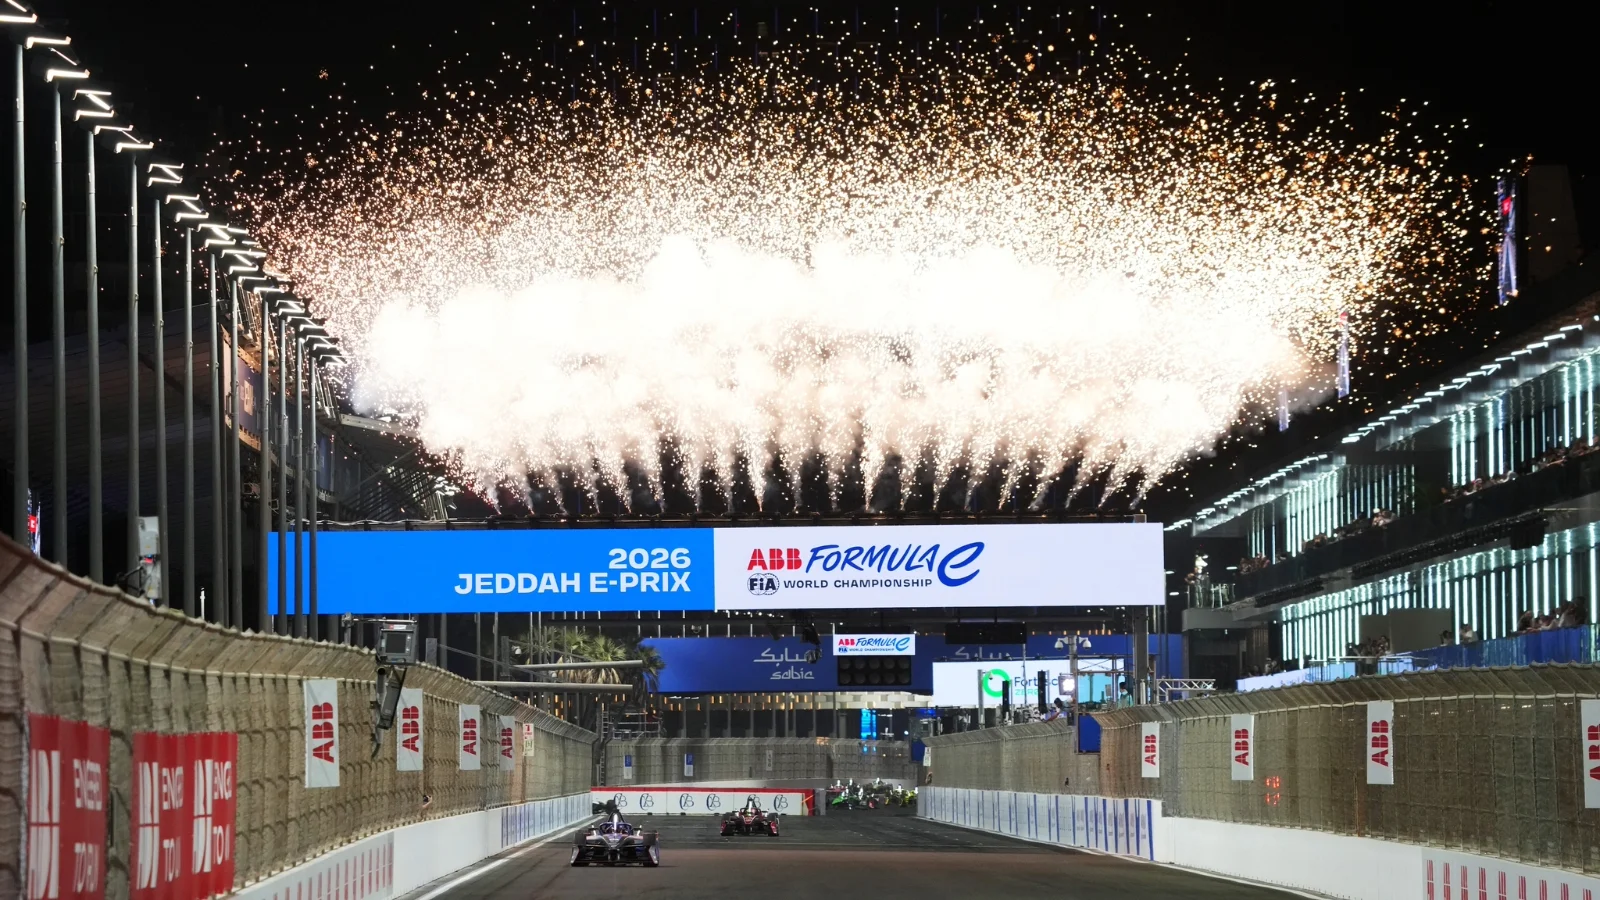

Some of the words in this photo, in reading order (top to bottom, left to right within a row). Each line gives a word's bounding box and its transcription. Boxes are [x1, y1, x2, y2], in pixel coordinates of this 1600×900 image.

[608, 547, 691, 569] 2026
[747, 548, 802, 570] ABB
[805, 543, 940, 573] FORMULA
[454, 572, 580, 594] JEDDAH
[589, 571, 691, 592] E-PRIX
[783, 579, 828, 588] WORLD
[833, 578, 932, 588] CHAMPIONSHIP
[838, 638, 855, 646] ABB
[856, 637, 897, 646] FORMULA
[770, 665, 815, 680] sabic
[312, 702, 334, 763] ABB
[402, 705, 419, 753] ABB
[463, 718, 477, 756] ABB
[501, 727, 513, 759] ABB
[1371, 719, 1389, 767] ABB
[1144, 734, 1157, 766] ABB
[1234, 728, 1249, 766] ABB
